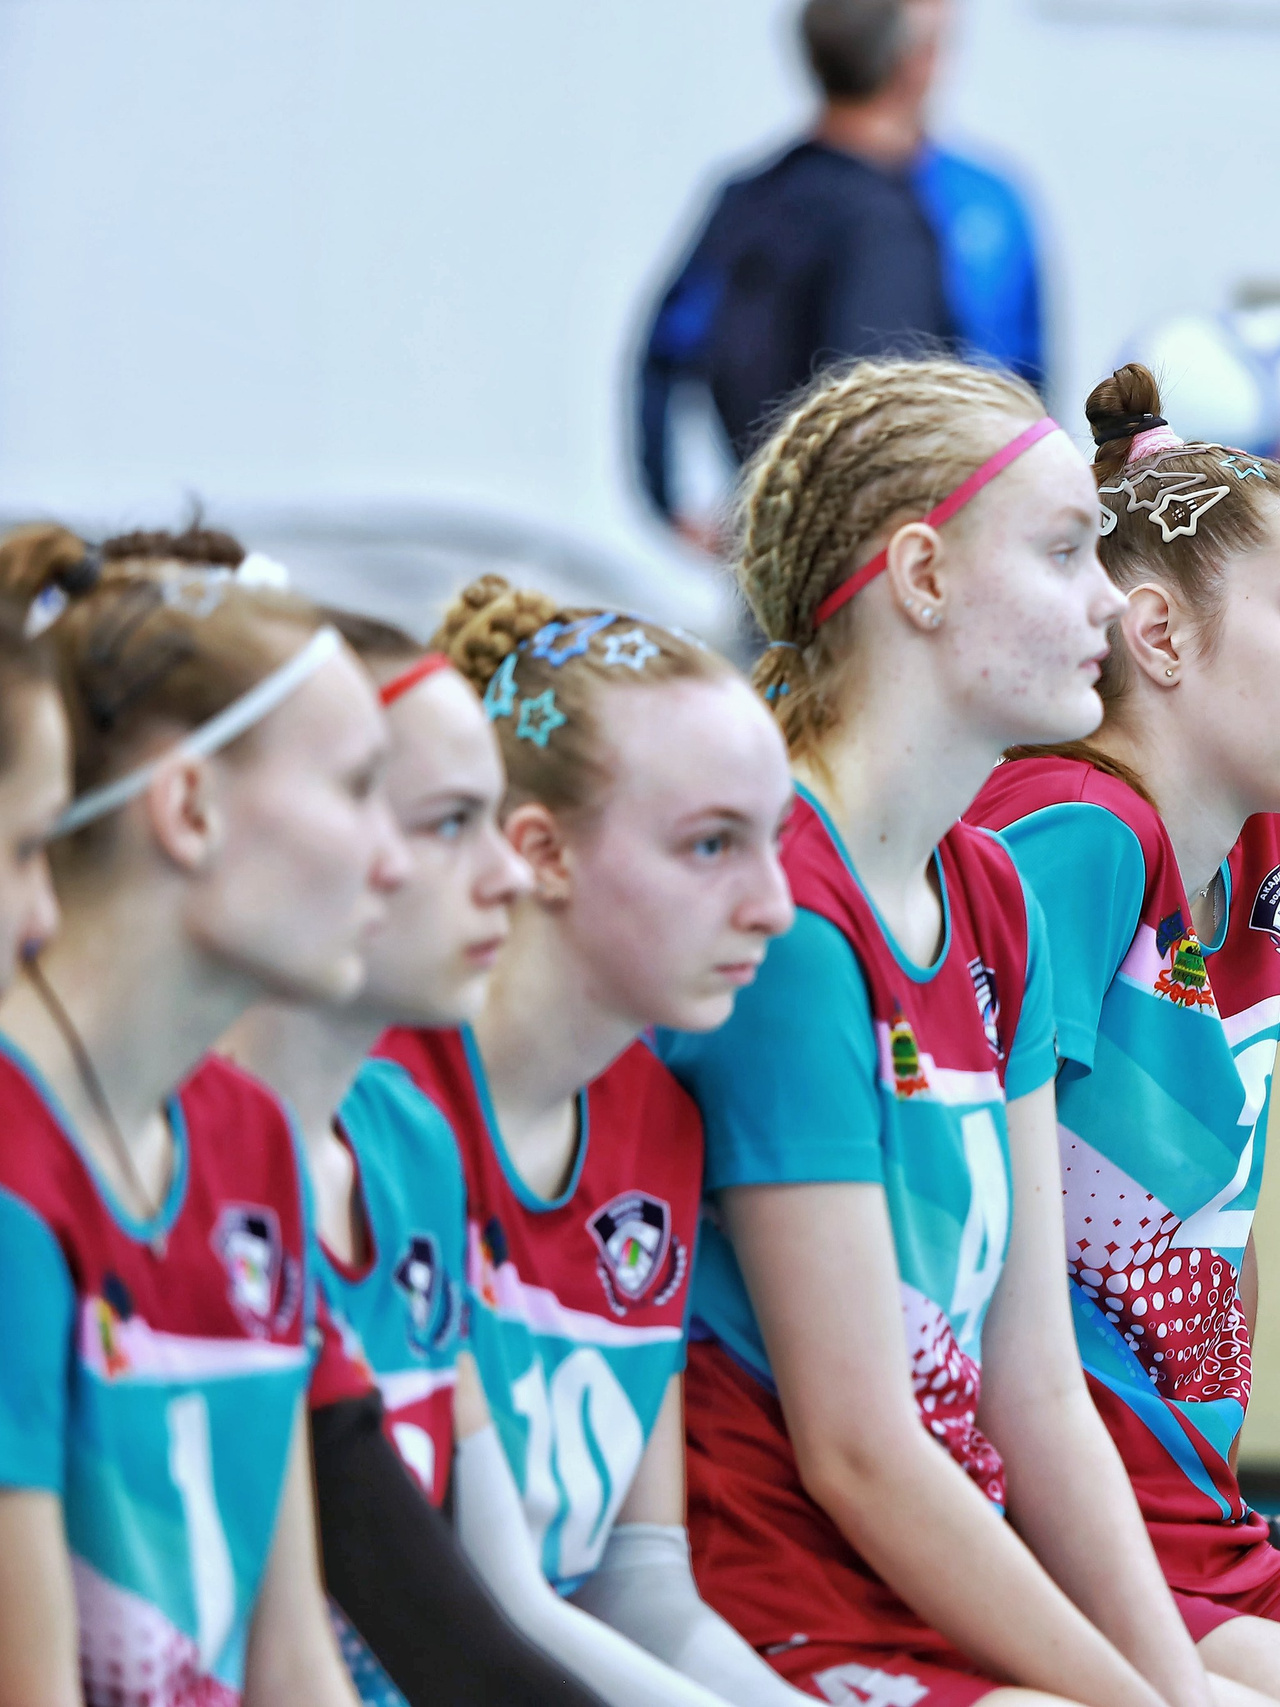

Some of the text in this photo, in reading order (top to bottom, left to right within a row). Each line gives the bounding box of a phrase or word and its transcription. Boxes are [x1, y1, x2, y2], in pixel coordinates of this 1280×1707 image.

[950, 1108, 1010, 1346] 4
[166, 1391, 236, 1673] 1
[511, 1347, 644, 1577] 10
